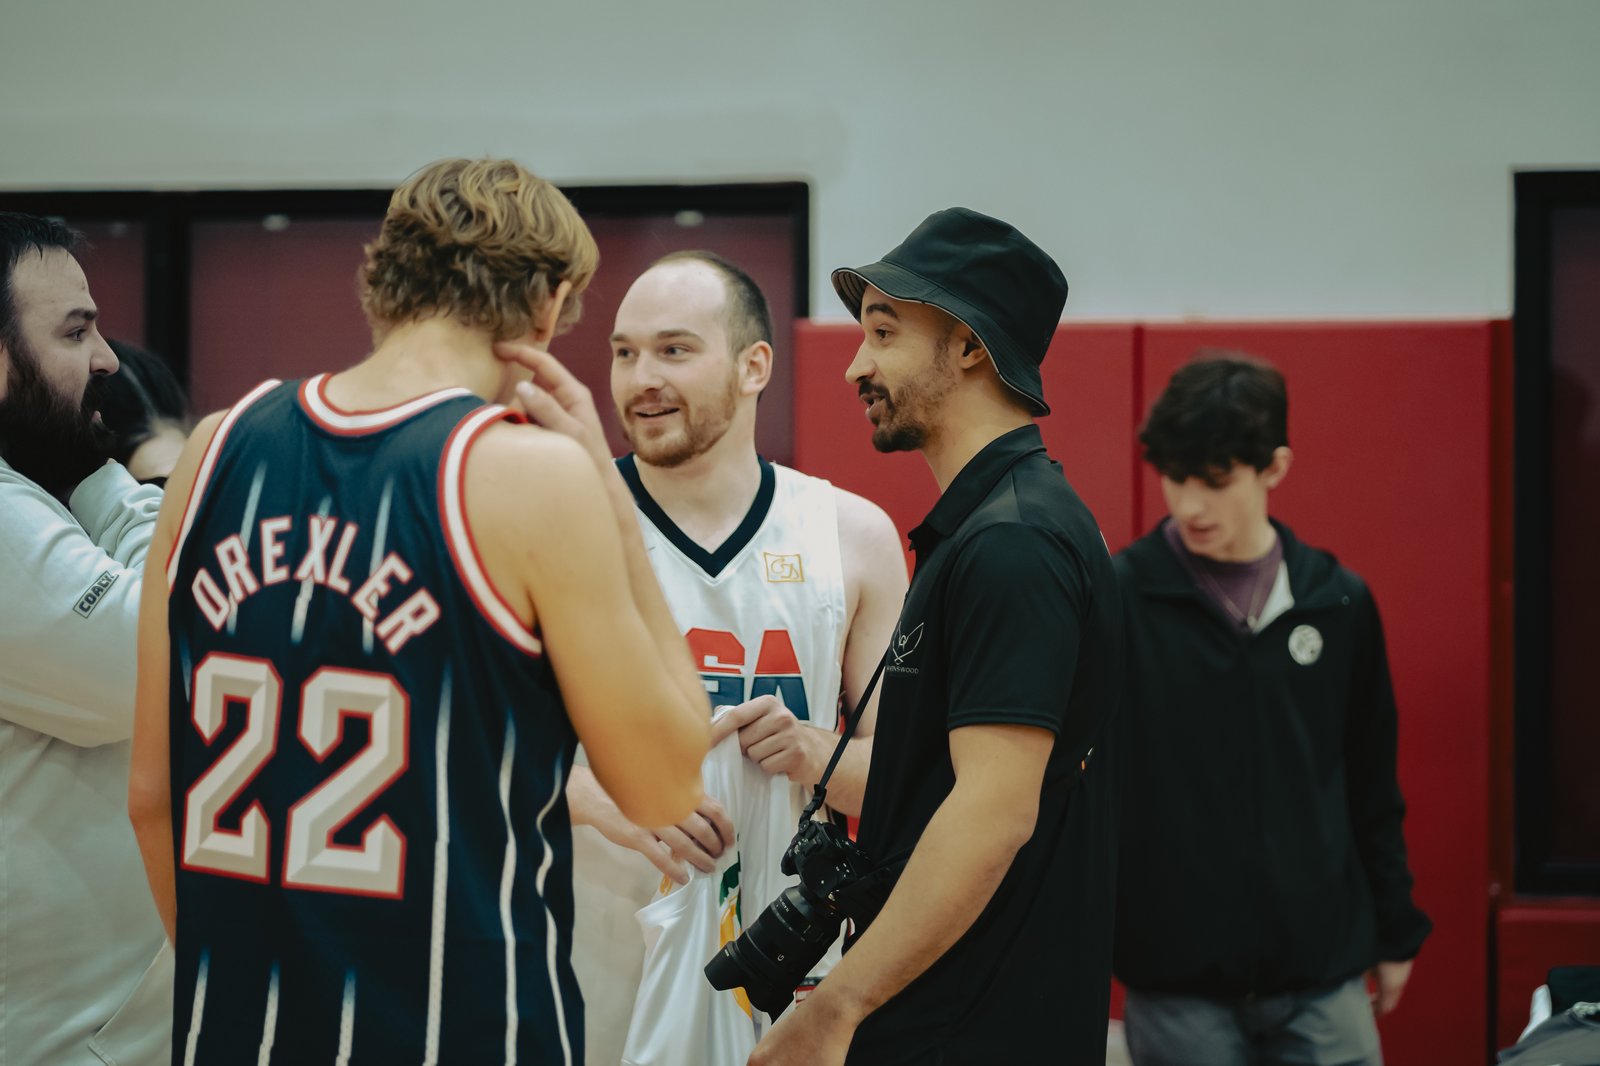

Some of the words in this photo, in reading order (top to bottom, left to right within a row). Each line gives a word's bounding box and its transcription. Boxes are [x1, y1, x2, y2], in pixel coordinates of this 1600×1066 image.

[192, 515, 441, 655] DREXLER
[685, 627, 810, 721] SA
[181, 650, 410, 900] 22
